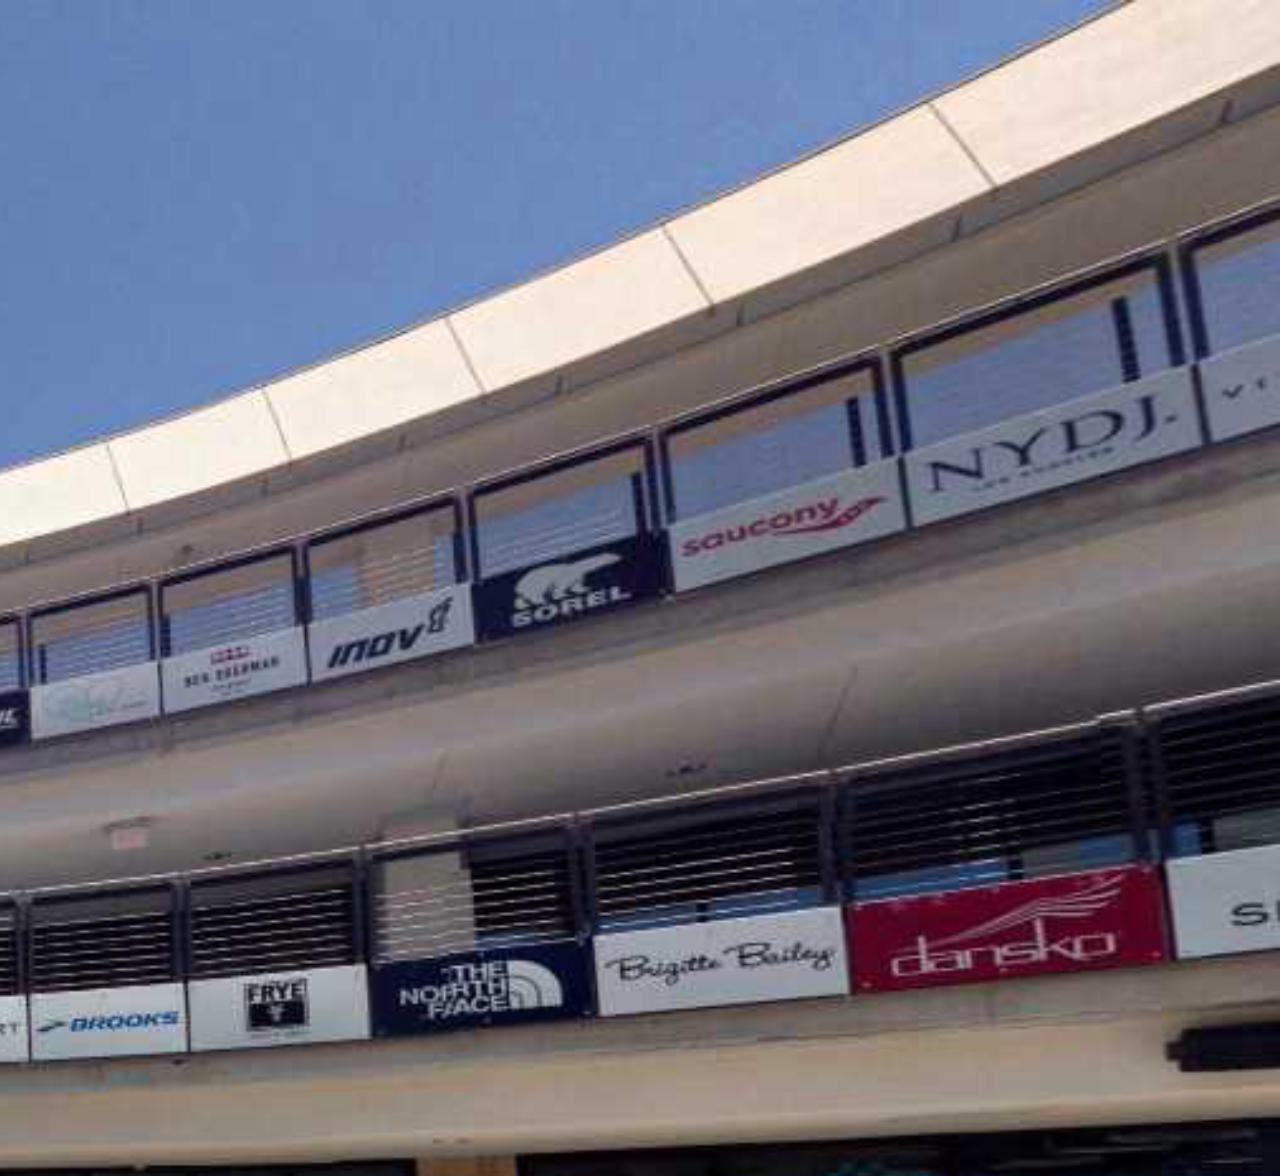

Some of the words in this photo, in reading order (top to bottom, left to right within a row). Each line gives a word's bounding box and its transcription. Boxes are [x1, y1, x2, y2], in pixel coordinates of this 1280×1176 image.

[680, 497, 840, 558] saucony
[510, 586, 632, 629] SOREL
[605, 954, 720, 986] Brigitte
[722, 941, 836, 973] Bailey
[890, 916, 1117, 978] dansko
[247, 979, 304, 1002] FRYE
[69, 1010, 182, 1033] BROOKS
